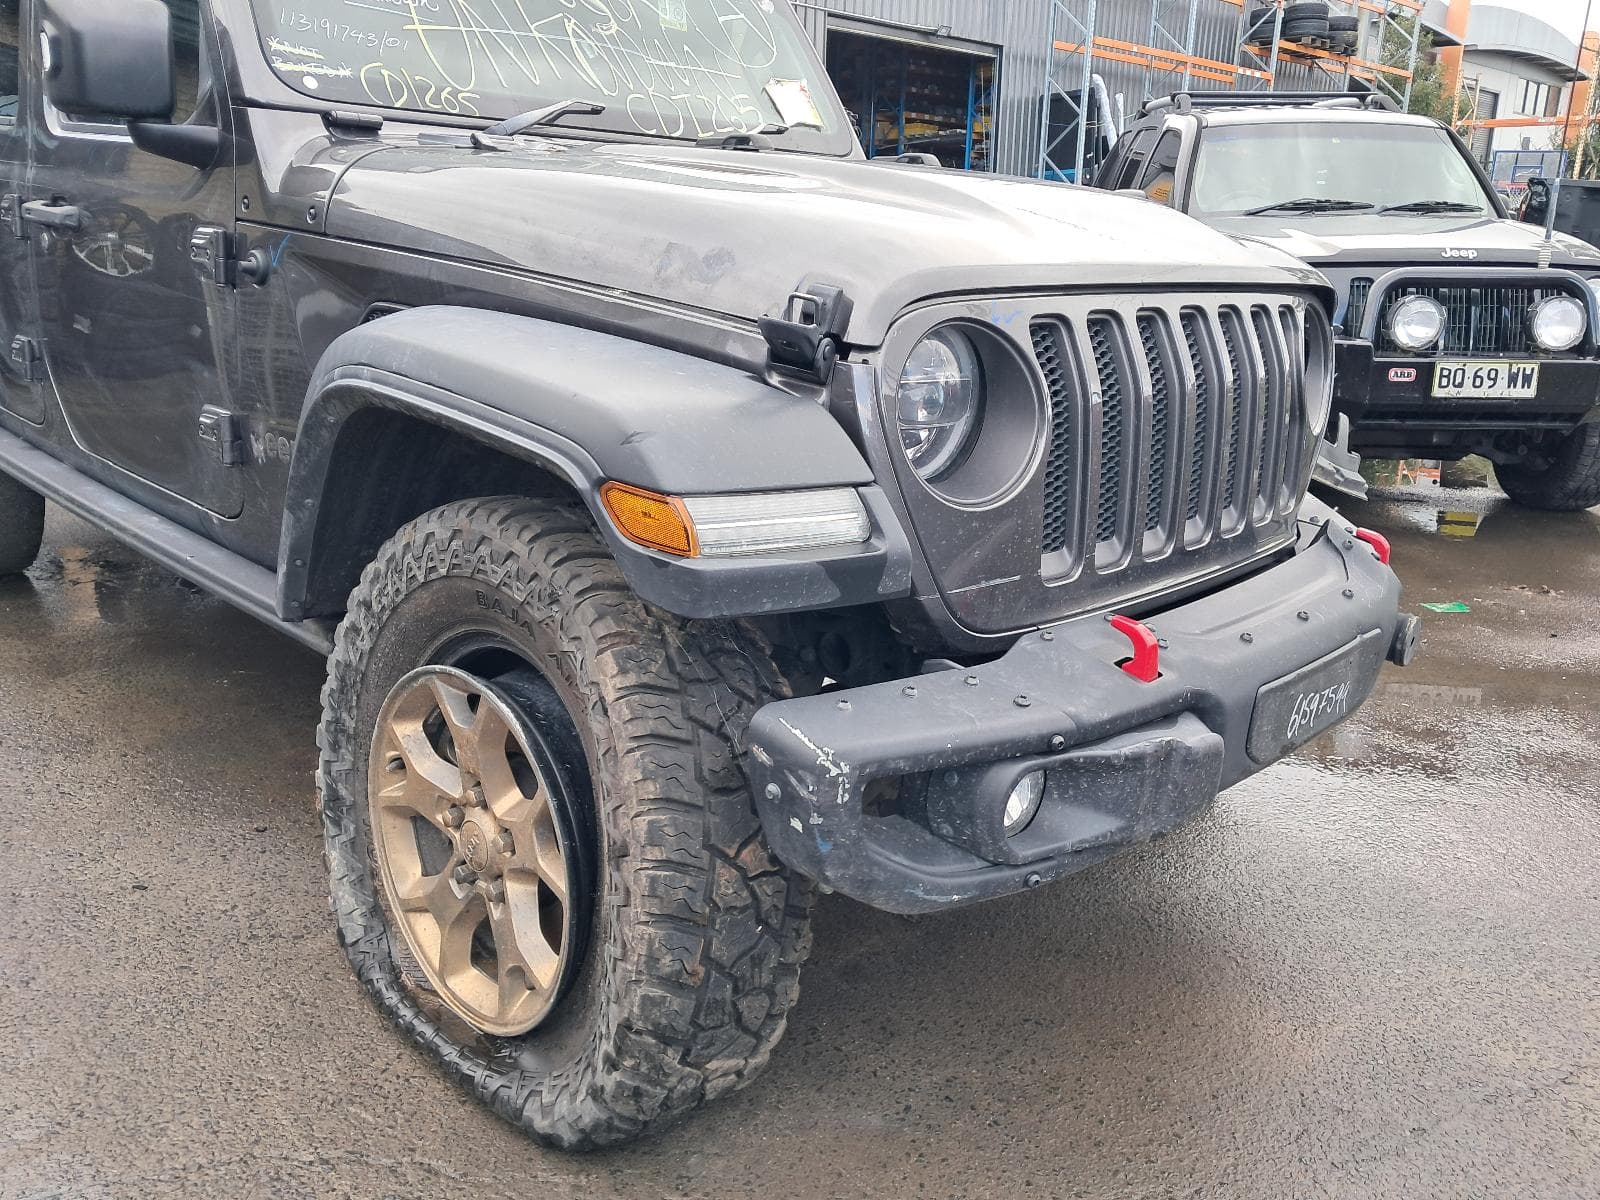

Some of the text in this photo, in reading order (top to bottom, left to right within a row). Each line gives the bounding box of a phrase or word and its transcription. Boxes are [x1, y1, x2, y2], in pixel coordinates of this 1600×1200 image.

[1441, 247, 1478, 259] Jeep
[1391, 369, 1414, 379] ARB
[475, 589, 537, 642] BAJA
